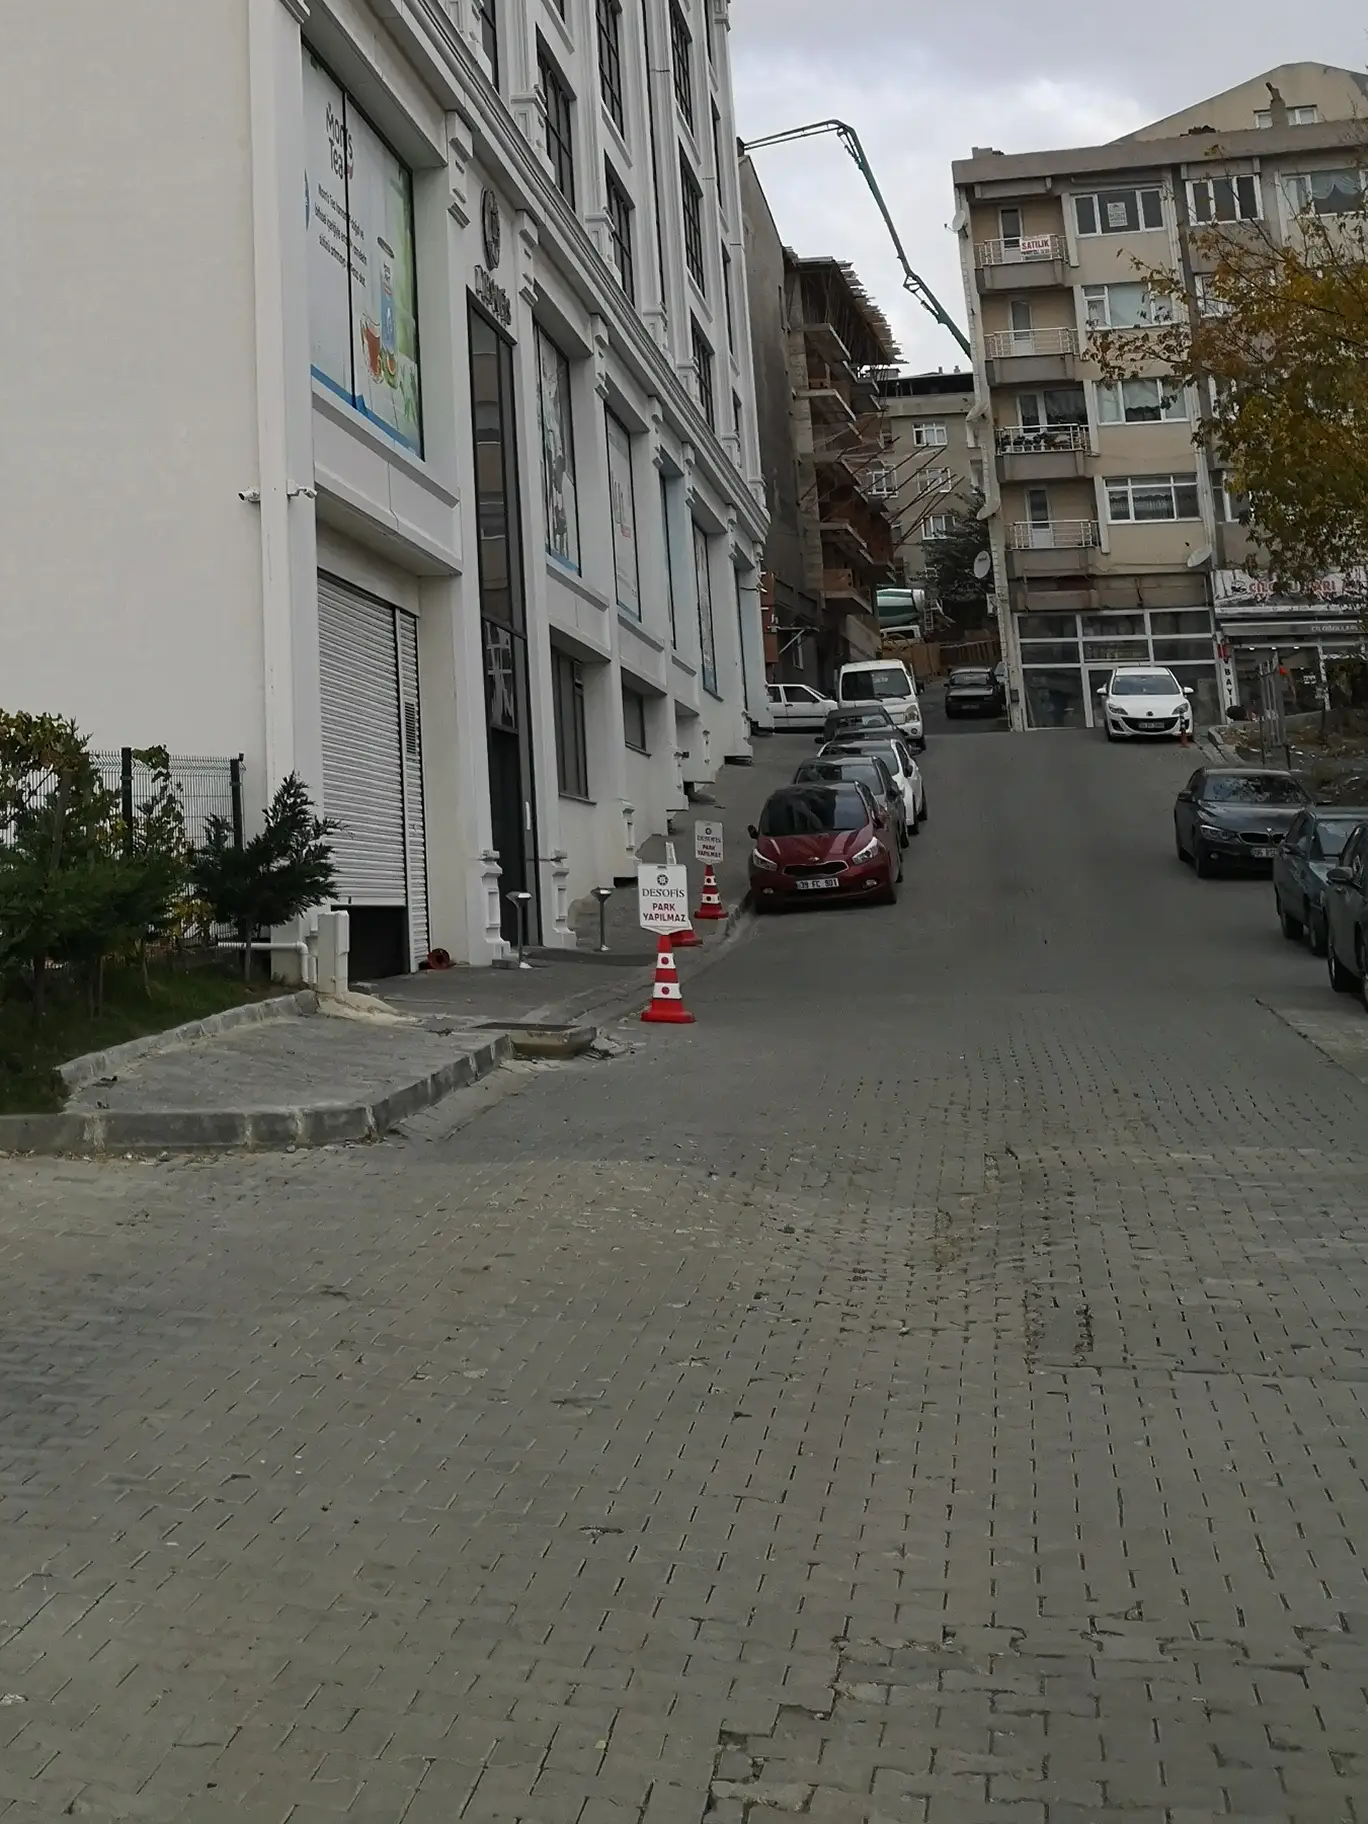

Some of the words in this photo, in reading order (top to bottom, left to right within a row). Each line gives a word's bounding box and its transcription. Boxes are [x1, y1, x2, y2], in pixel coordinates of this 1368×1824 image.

[328, 136, 344, 180] Tea
[1022, 238, 1050, 250] SATILIK
[652, 902, 676, 911] PARK
[642, 913, 686, 922] YAPILMAZ
